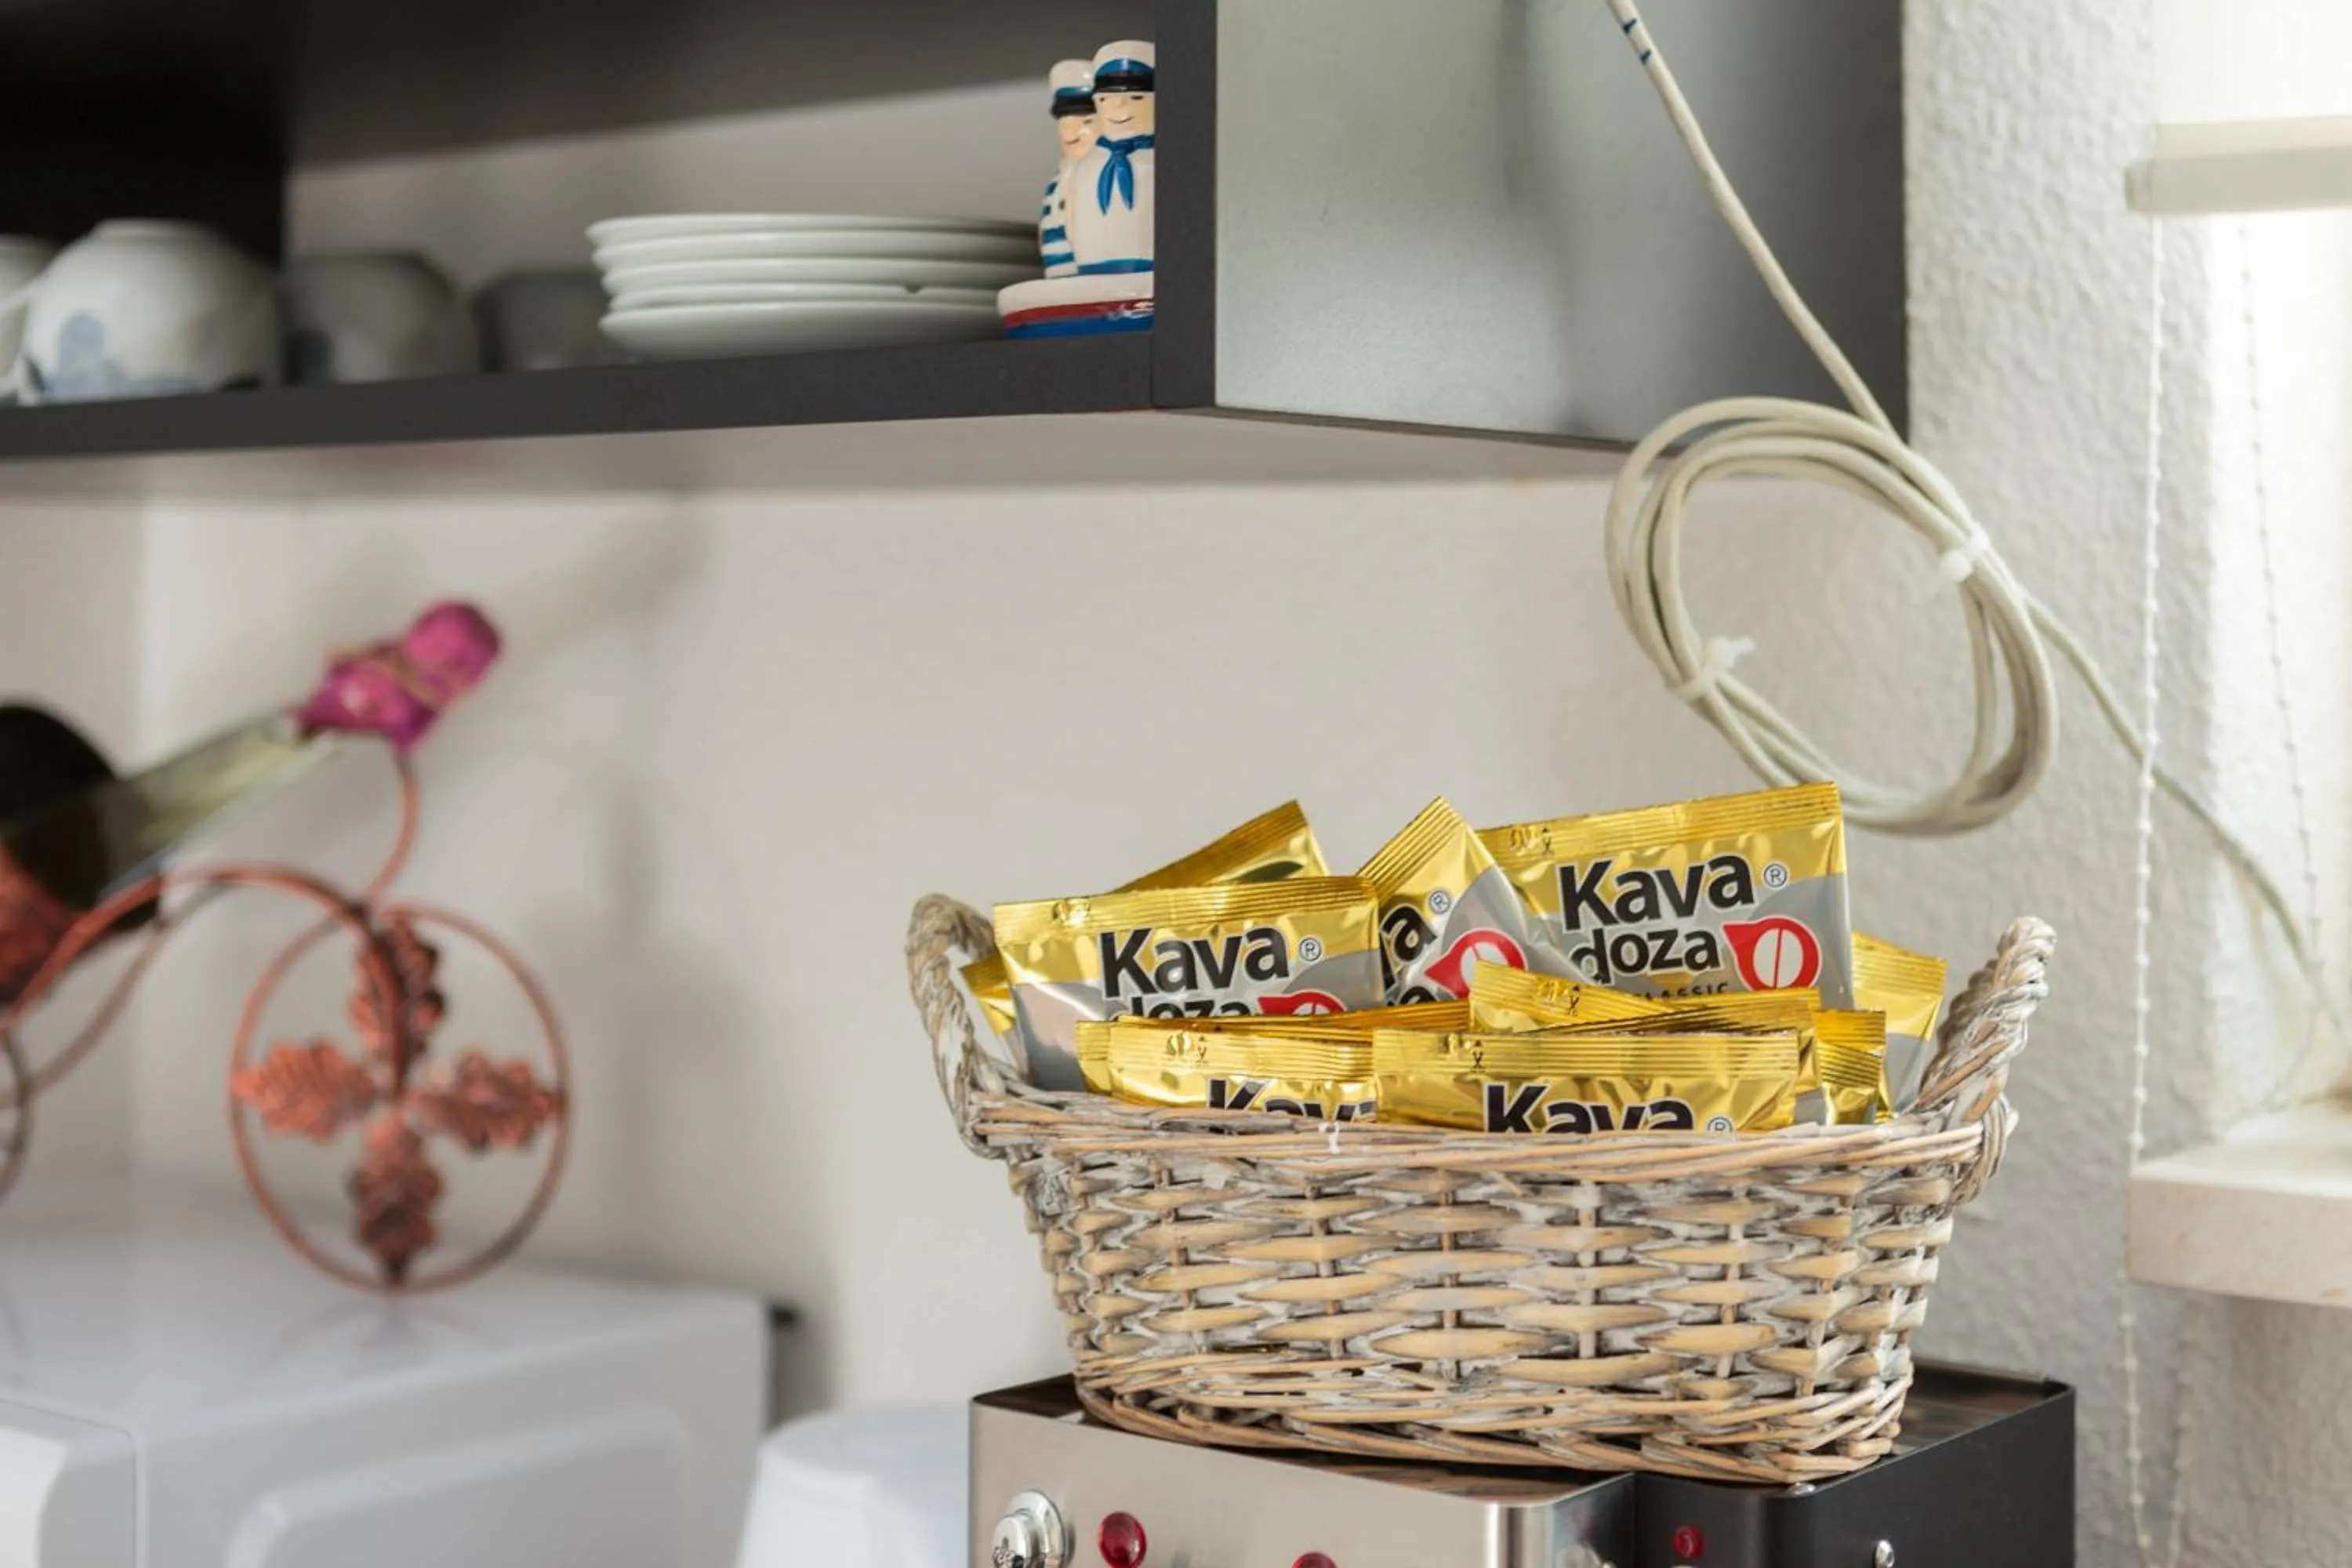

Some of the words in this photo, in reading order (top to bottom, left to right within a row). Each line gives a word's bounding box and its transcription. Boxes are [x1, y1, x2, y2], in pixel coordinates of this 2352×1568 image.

[1559, 855, 1755, 931] Kava
[1099, 927, 1290, 999] Kava
[1569, 927, 1721, 985] doza
[1633, 982, 1729, 1001] ASSIC
